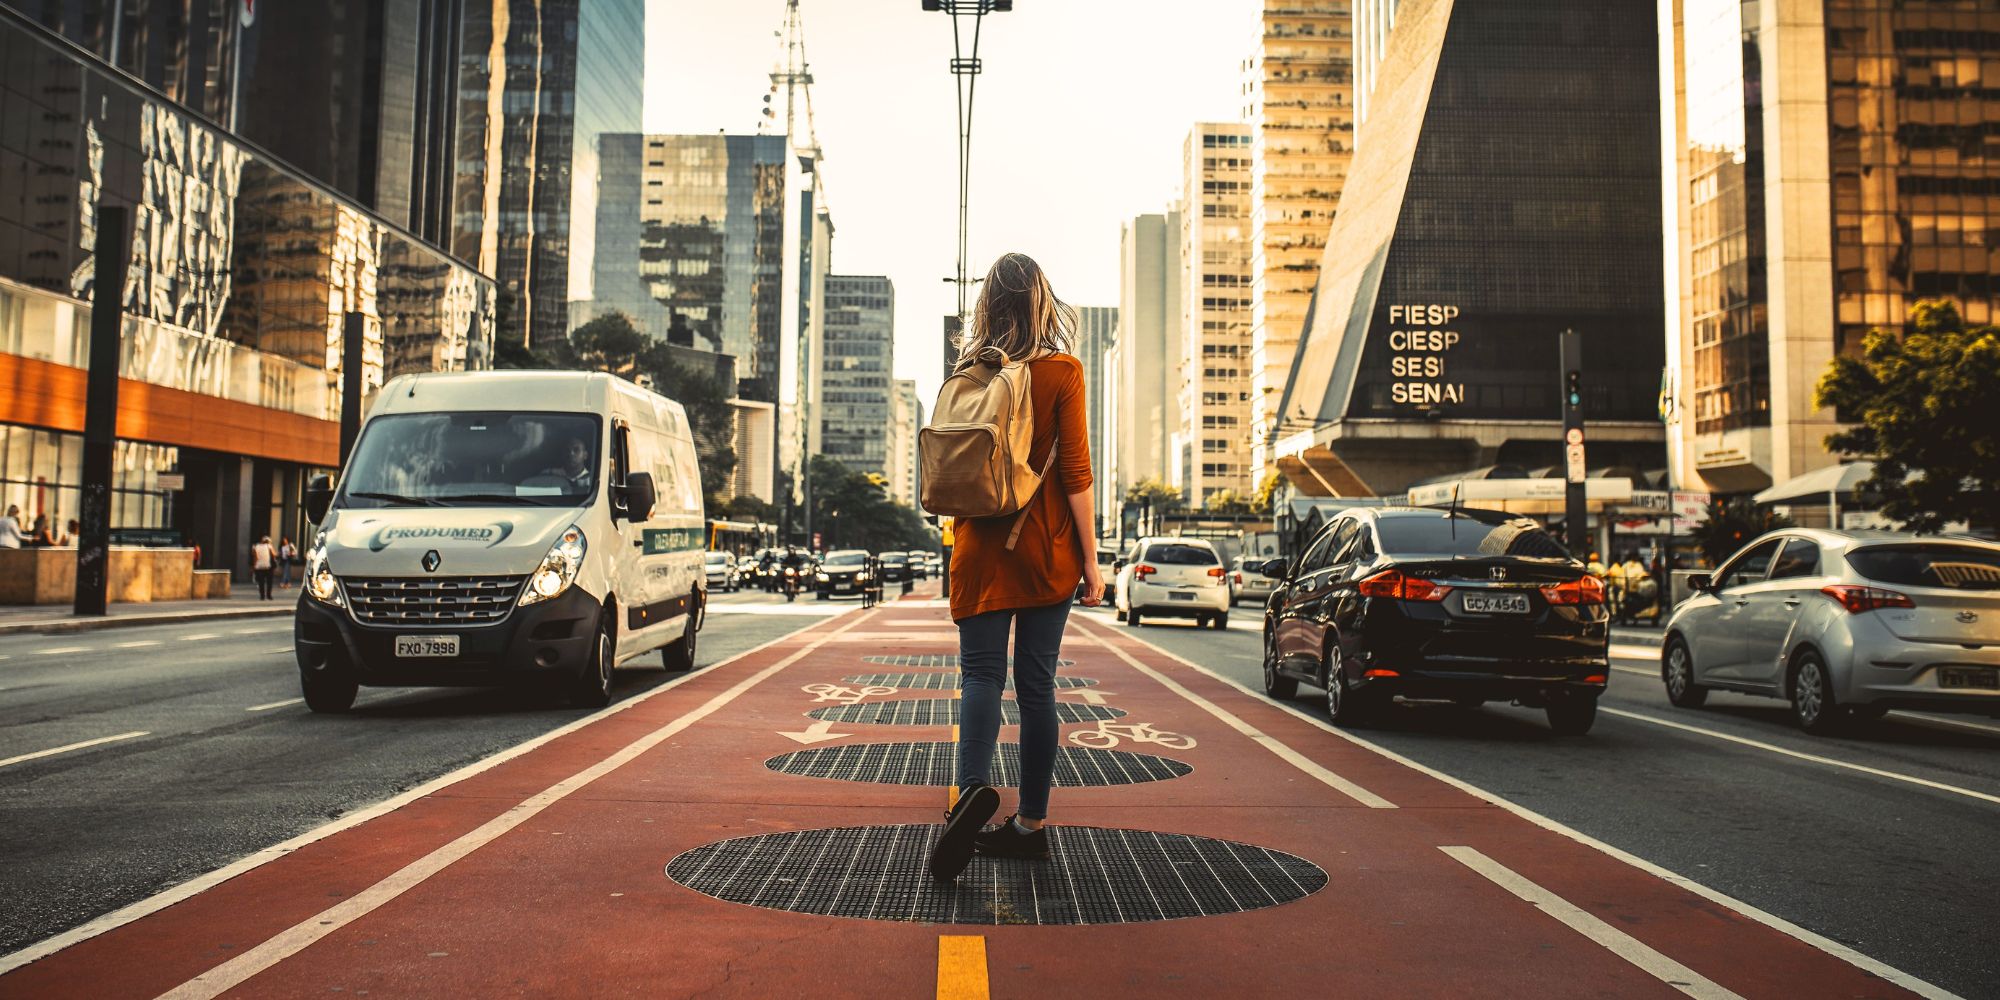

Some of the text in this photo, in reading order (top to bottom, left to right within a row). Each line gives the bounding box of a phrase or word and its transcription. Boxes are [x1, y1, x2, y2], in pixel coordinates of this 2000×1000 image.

[1389, 304, 1459, 325] FIESP
[1389, 330, 1459, 351] CIESP
[1391, 356, 1444, 377] SESI
[1391, 382, 1465, 404] SENAI
[386, 527, 493, 539] PRODUMED
